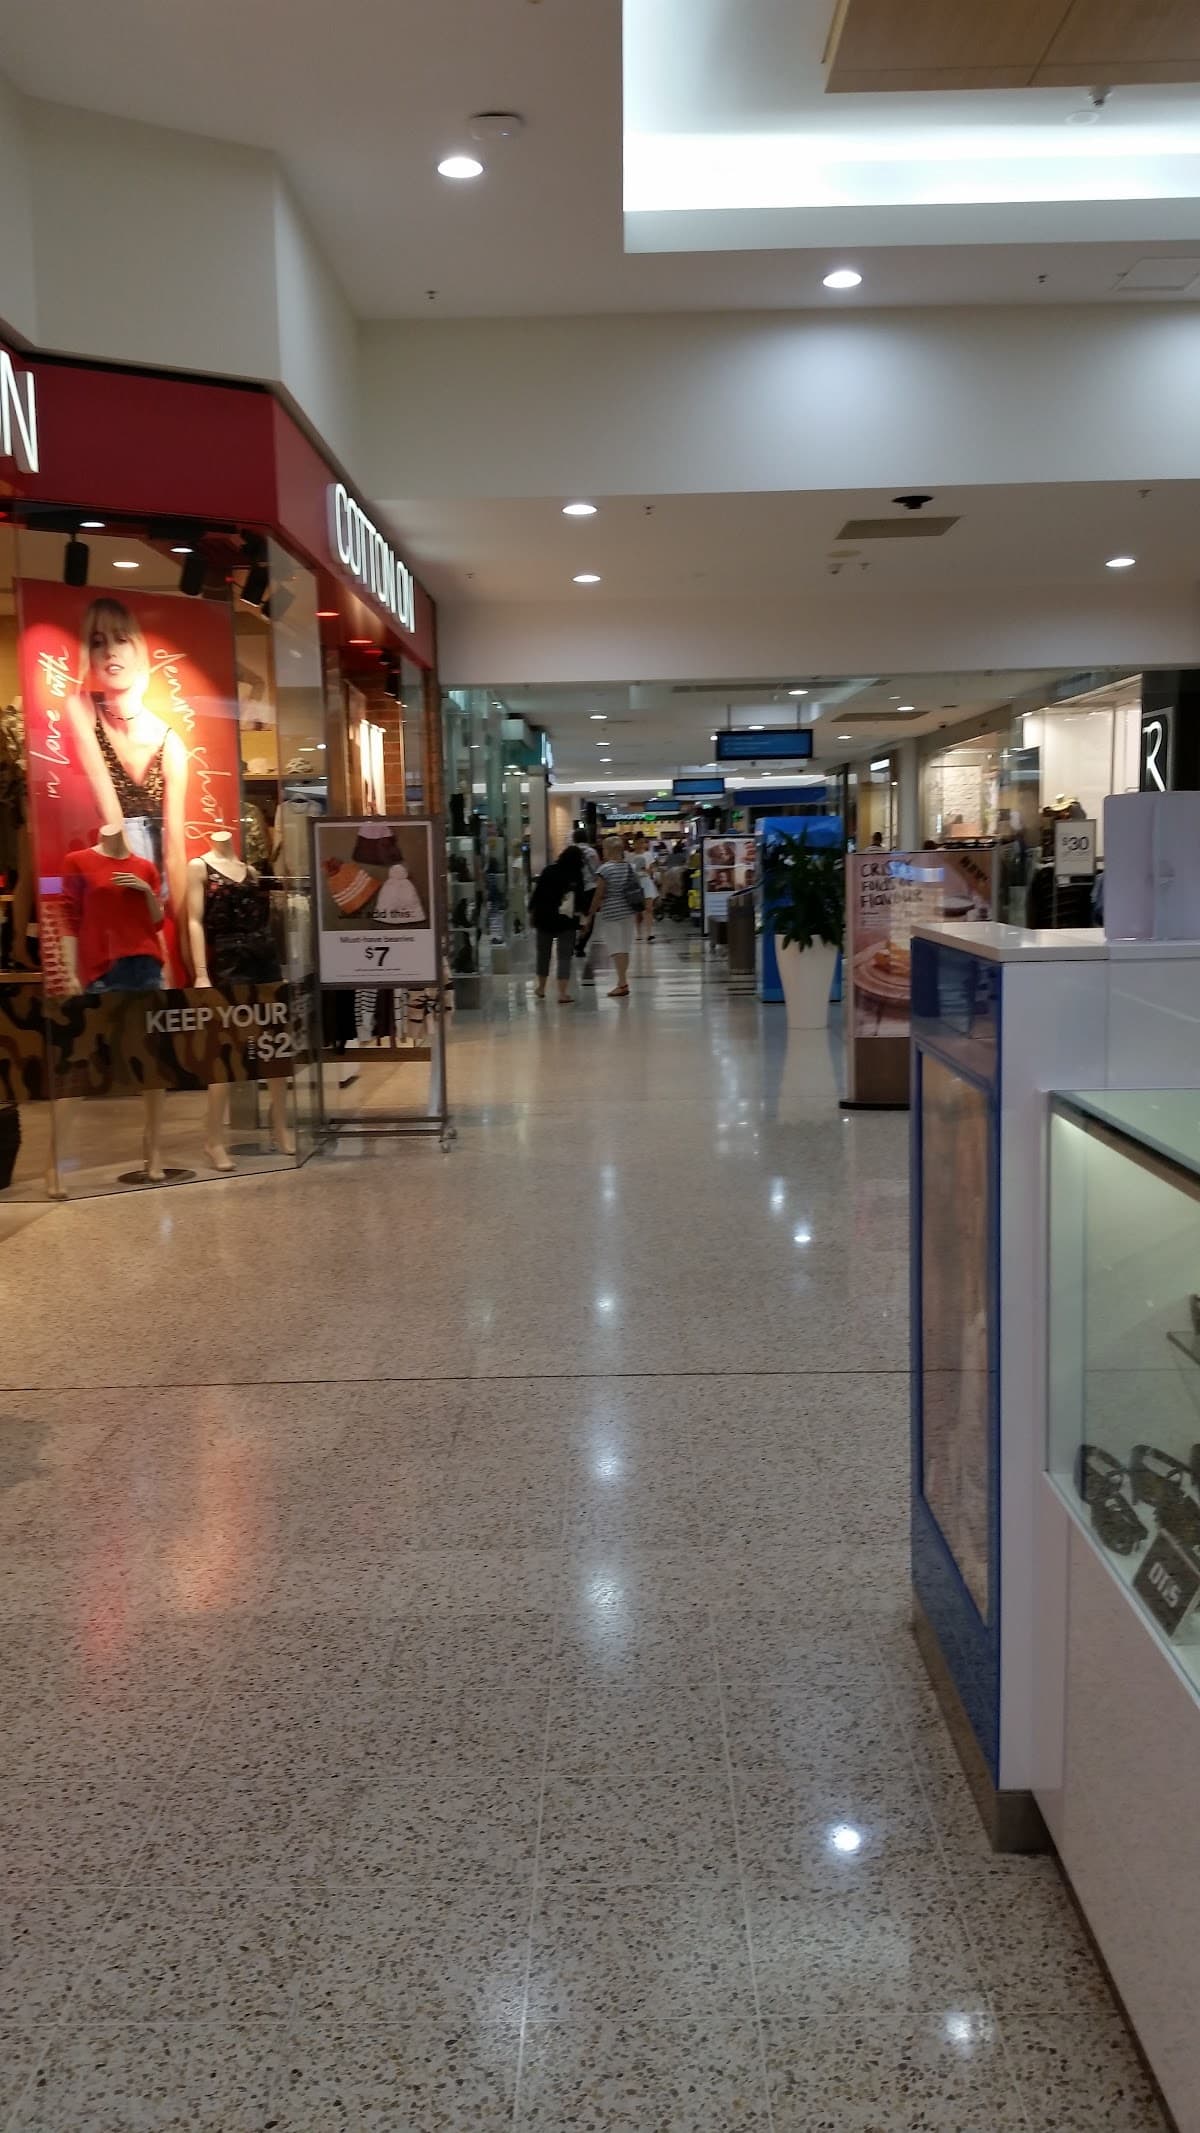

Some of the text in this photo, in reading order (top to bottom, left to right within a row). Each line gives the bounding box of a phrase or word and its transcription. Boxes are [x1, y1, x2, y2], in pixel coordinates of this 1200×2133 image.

[328, 483, 416, 634] COTTON ON
[29, 709, 71, 765] love
[364, 946, 390, 967] $7
[145, 1002, 288, 1034] KEEP YOUR
